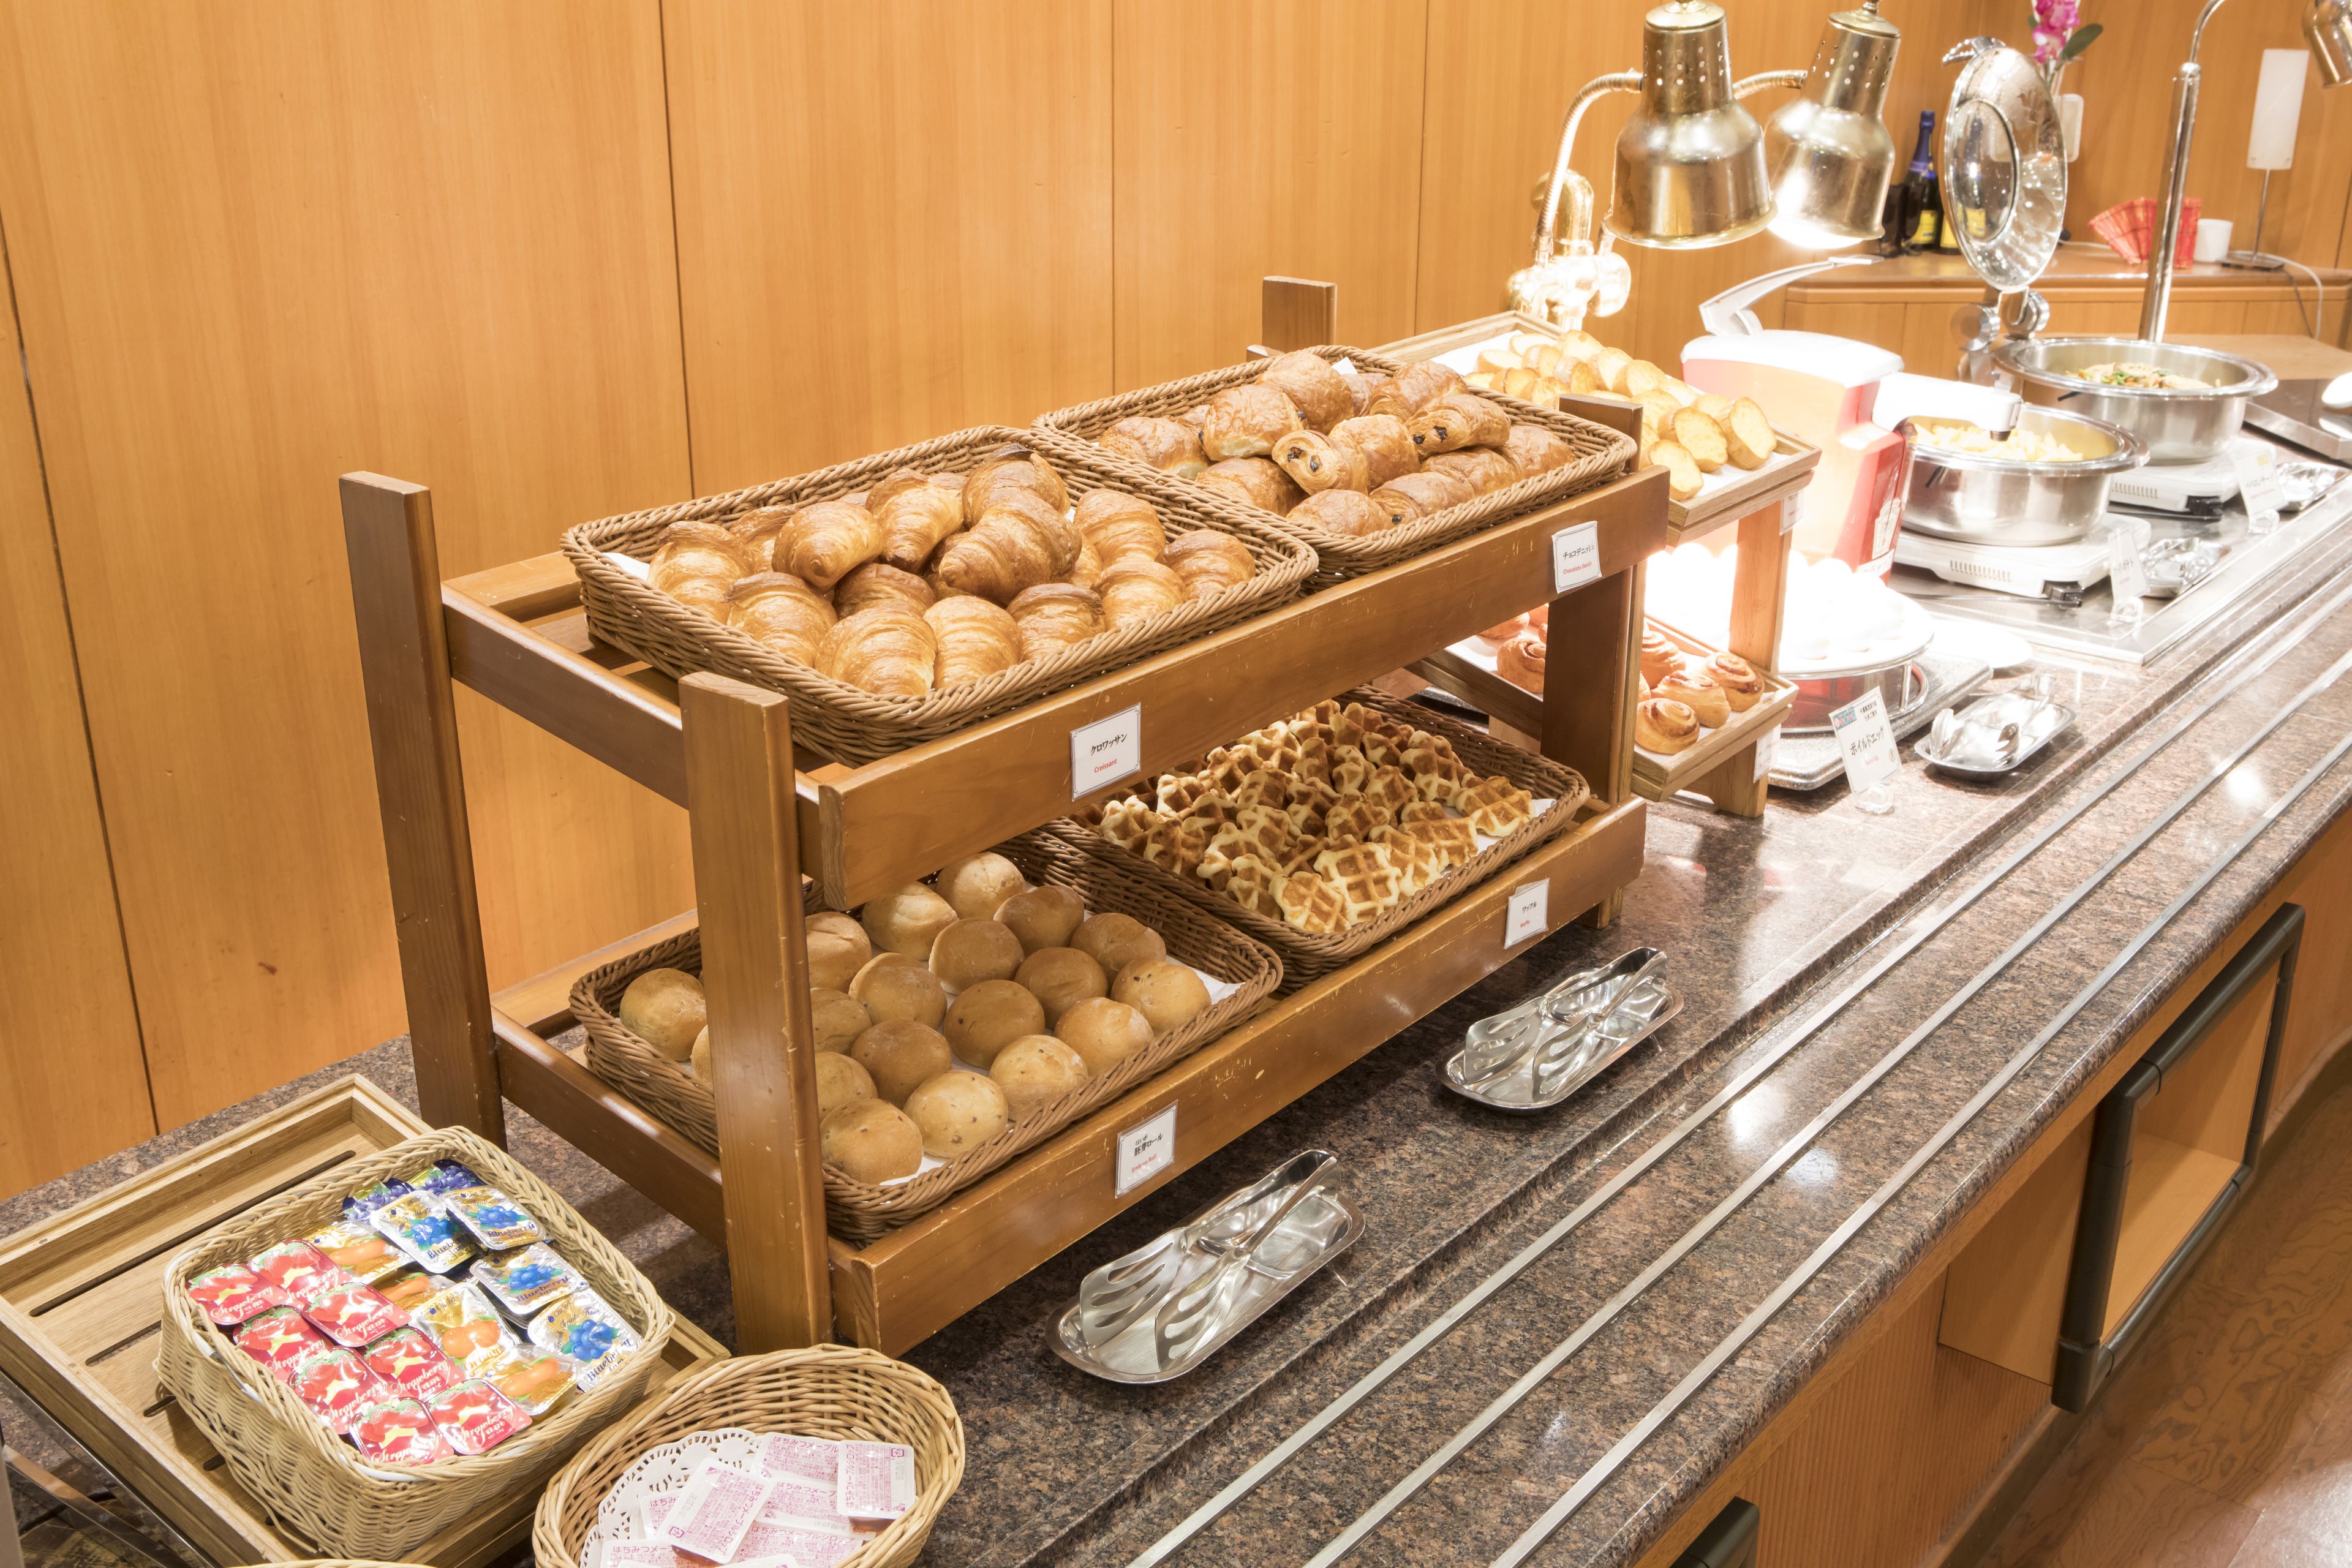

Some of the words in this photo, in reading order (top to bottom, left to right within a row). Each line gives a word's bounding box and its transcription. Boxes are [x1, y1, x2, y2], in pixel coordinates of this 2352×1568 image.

[1562, 545, 1594, 560] チョコデニッシュ
[1563, 565, 1581, 575] Chocolate
[1090, 734, 1128, 756] クロワッサン
[1094, 758, 1117, 773] Croissant
[1522, 901, 1537, 913] ワッフル
[1132, 1160, 1148, 1172] Embryo
[1148, 1153, 1157, 1163] Roll
[487, 1223, 535, 1238] Blueberry
[516, 1276, 568, 1302] Blueberry
[210, 1286, 274, 1317] Strawberry
[334, 1304, 393, 1338] Strawberry
[390, 1359, 448, 1396] Strawberry
[846, 1444, 855, 1507] はちみつメープルシロップ
[718, 1483, 764, 1556] はちみつメープルシロップ
[751, 1526, 856, 1544] はちみつメープルシロップ
